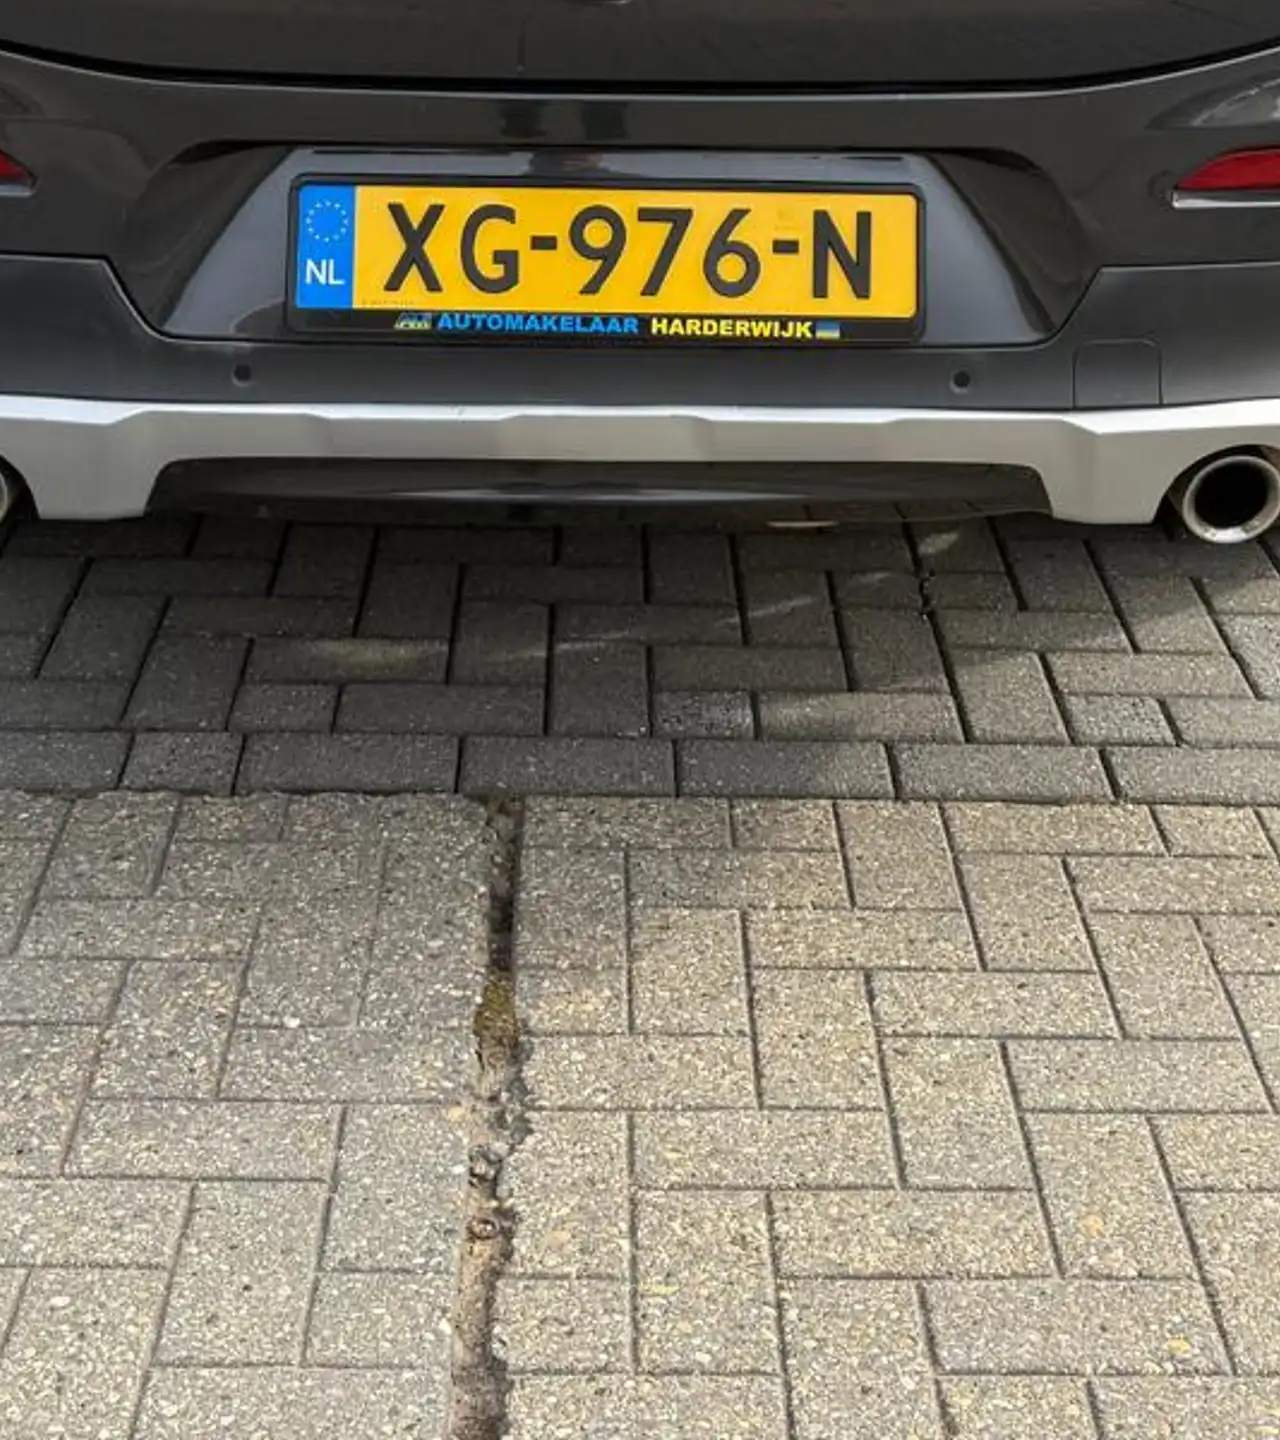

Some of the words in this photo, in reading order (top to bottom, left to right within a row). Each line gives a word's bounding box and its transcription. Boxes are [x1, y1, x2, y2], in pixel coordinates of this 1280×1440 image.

[383, 203, 872, 300] XG-976-N
[305, 260, 345, 286] NL
[436, 312, 640, 335] AUTOMAKELAAR
[651, 316, 813, 340] HARDERWIJK
